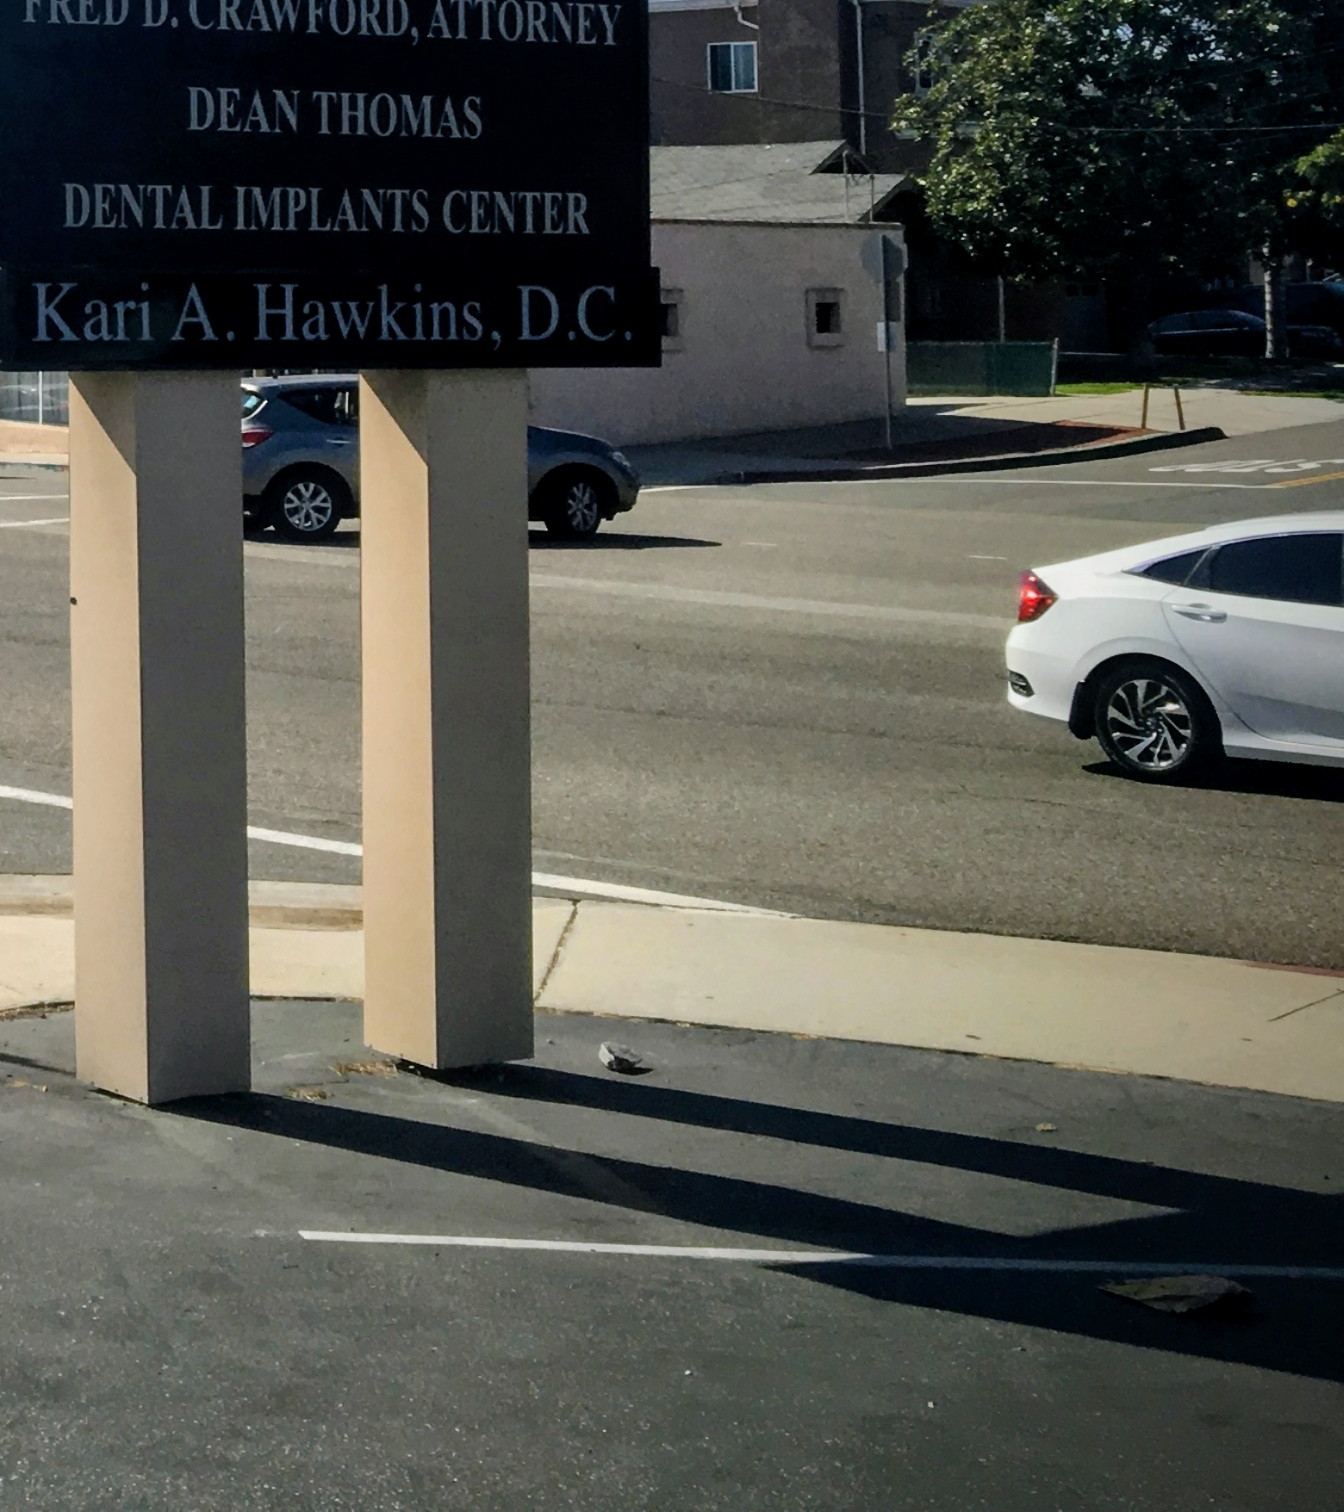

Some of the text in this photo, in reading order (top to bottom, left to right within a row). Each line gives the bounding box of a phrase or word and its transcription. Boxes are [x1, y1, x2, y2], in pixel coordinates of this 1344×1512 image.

[187, 86, 483, 140] DEAN THOMAS
[63, 183, 590, 234] DENTAL IMPLANTS CENTER
[32, 283, 633, 350] Kari A. Hawkins, D.C.
